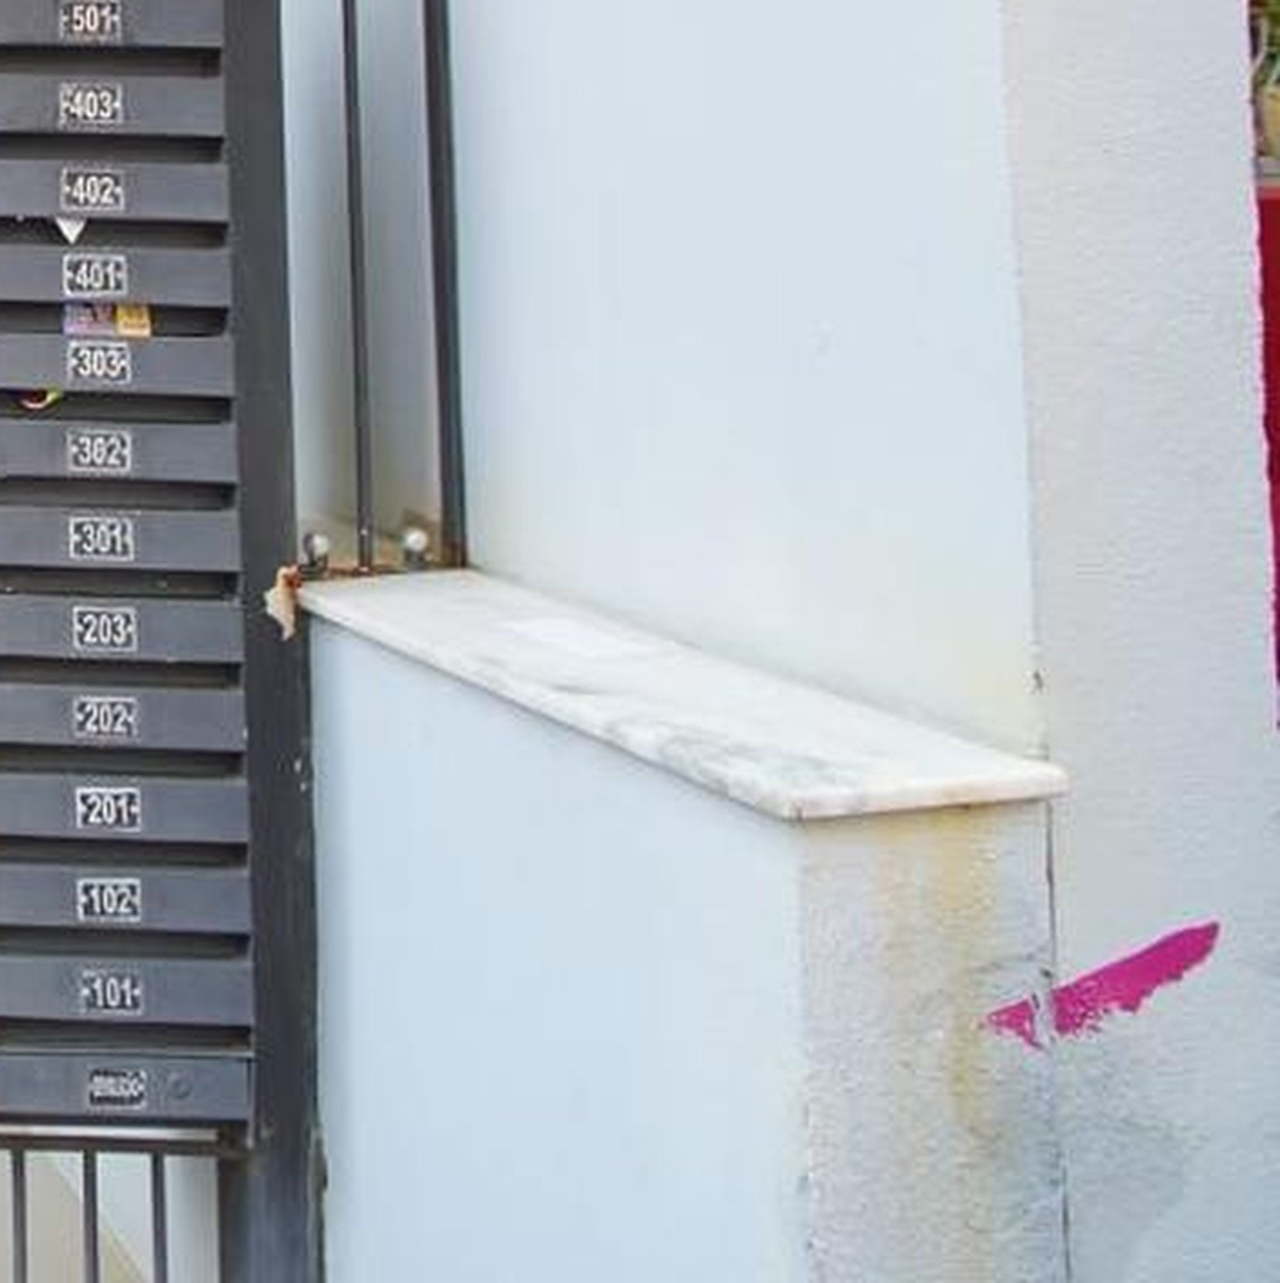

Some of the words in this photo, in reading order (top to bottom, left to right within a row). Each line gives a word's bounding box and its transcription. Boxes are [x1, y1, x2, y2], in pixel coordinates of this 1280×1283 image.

[72, 6, 113, 32] 501
[70, 91, 114, 118] 403
[71, 176, 116, 205] 402
[75, 261, 118, 291] 401
[77, 349, 121, 377] 303
[82, 523, 125, 552] 301
[82, 614, 128, 645] 203
[84, 703, 129, 733] 202
[86, 795, 132, 825] 201
[90, 887, 132, 914] 102
[94, 978, 135, 1007] 101
